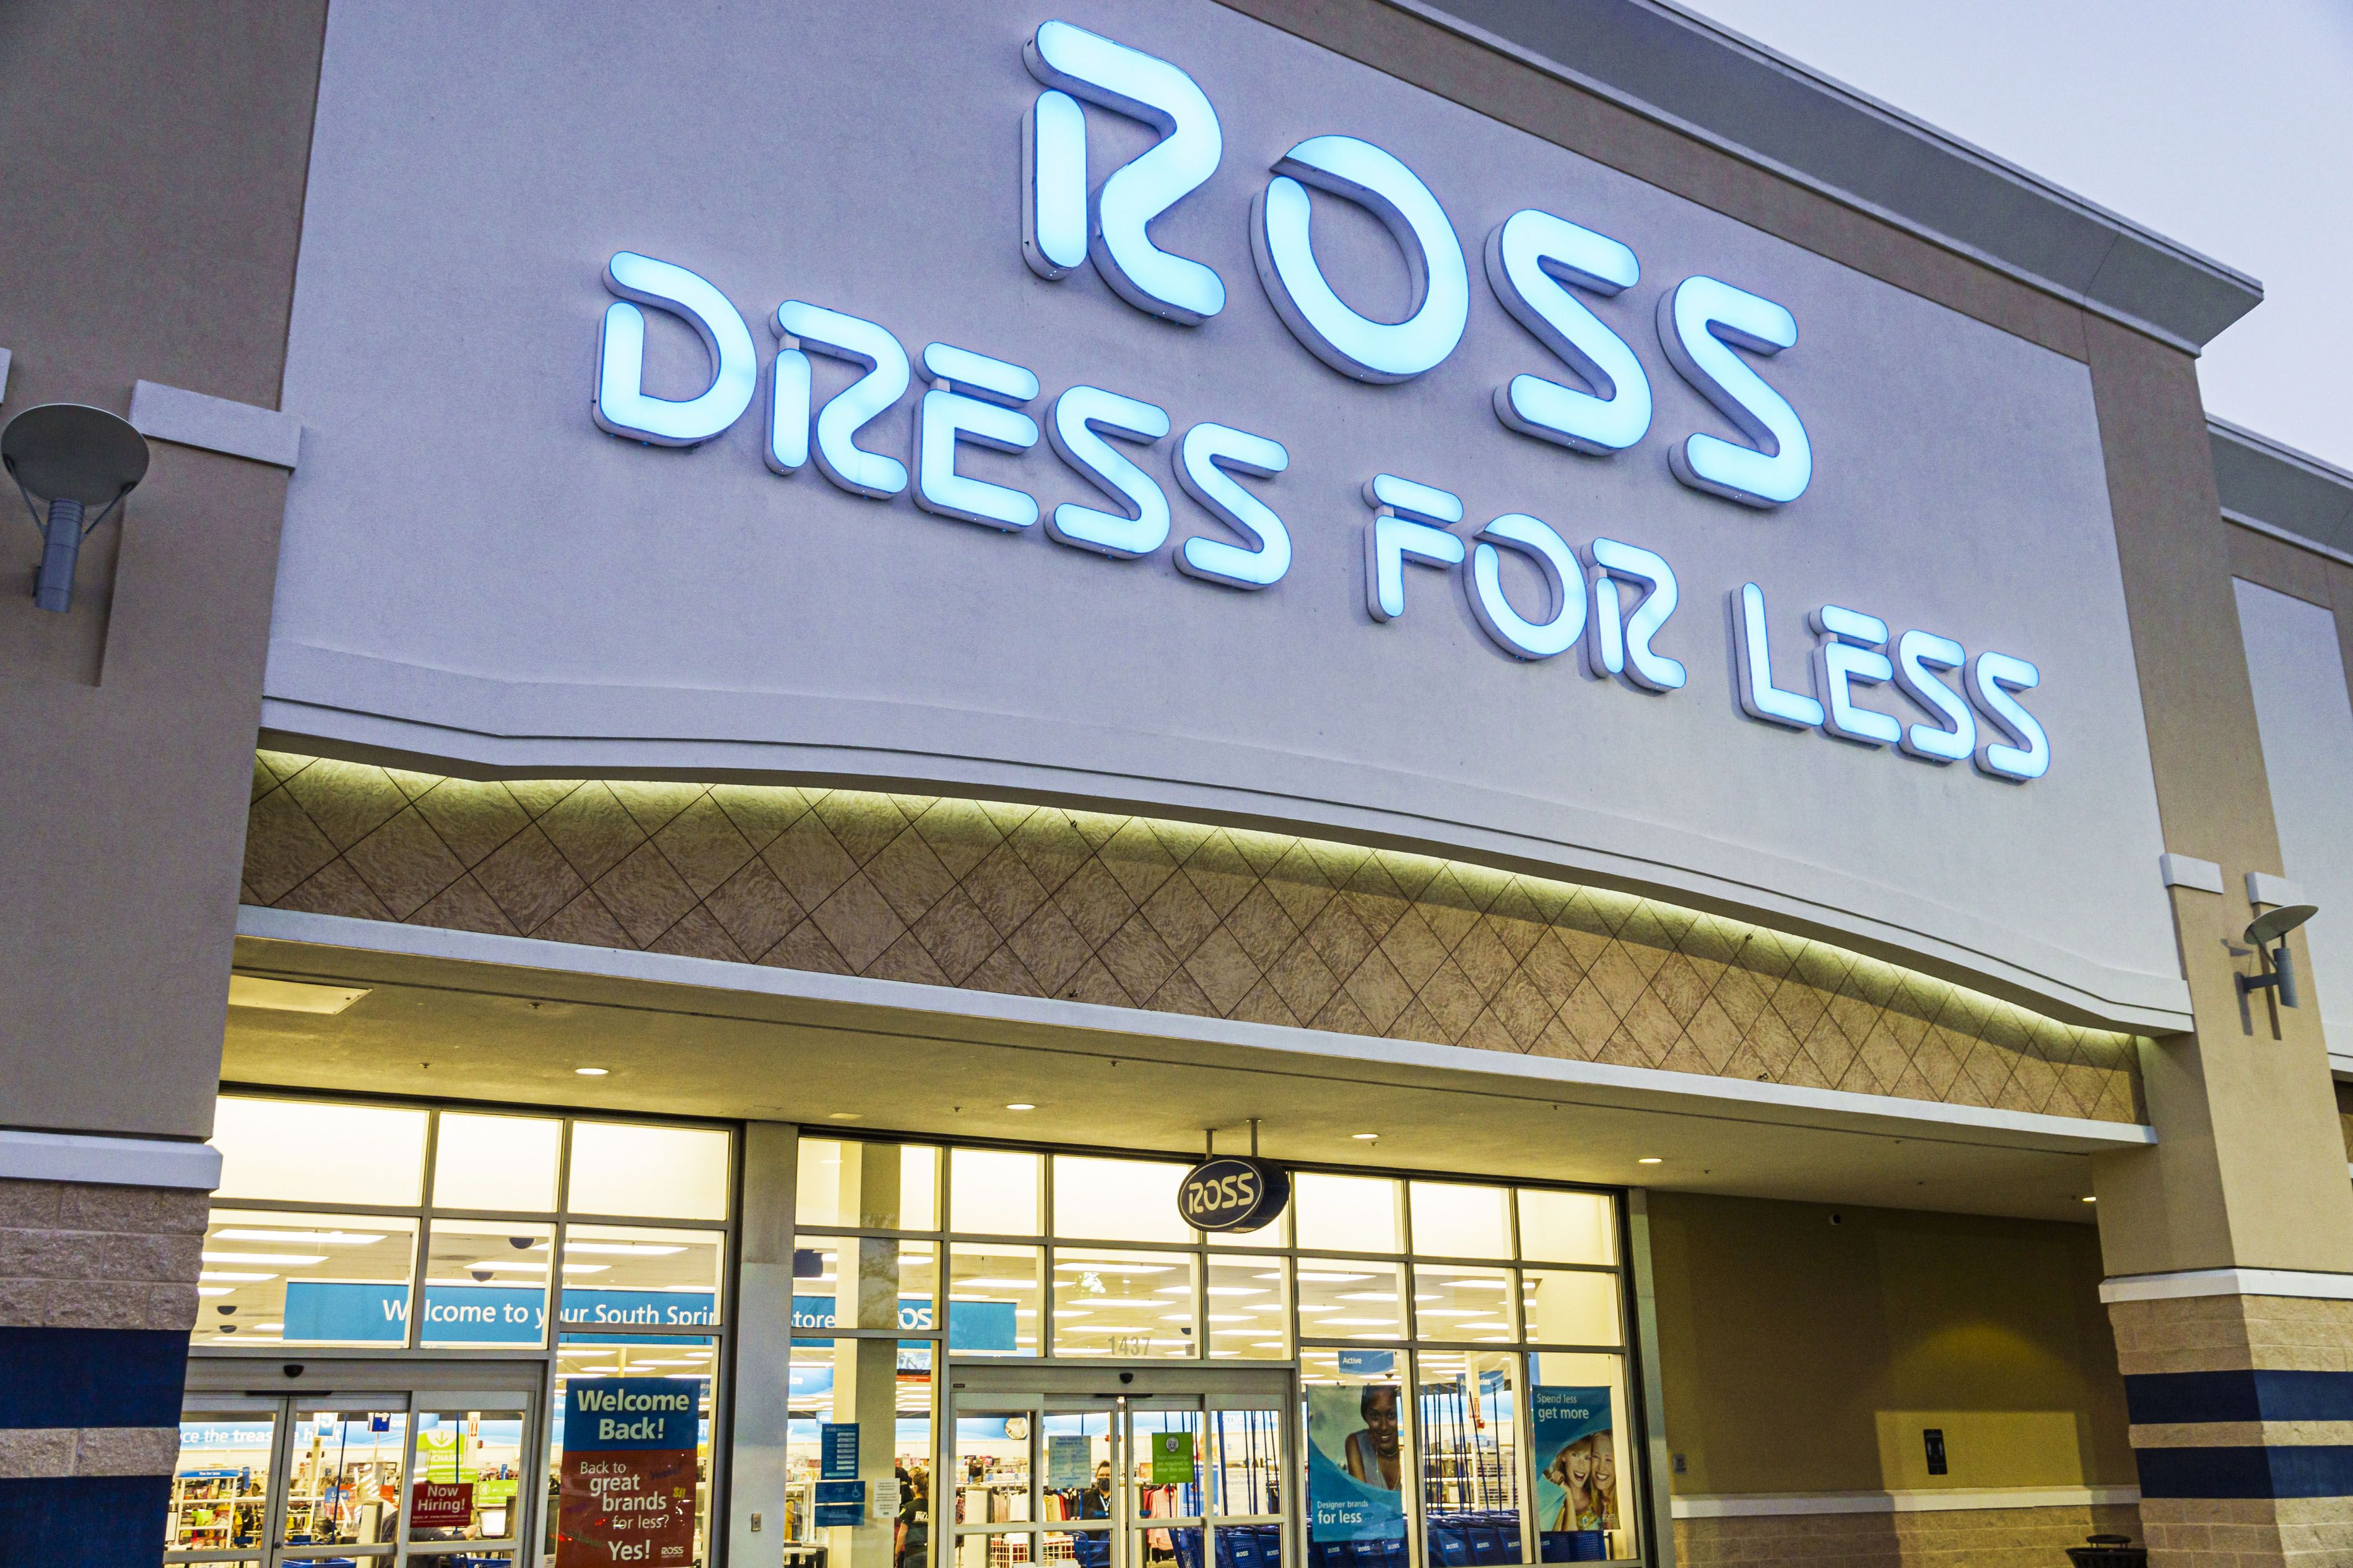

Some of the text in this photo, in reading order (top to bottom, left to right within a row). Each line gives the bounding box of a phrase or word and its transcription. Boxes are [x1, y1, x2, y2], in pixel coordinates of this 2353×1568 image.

[1029, 21, 1813, 503] ROSS
[596, 251, 2050, 779] DRESS FOR LESS
[1188, 1172, 1254, 1215] ROSS
[382, 1299, 496, 1322] Wlcome
[503, 1303, 528, 1323] to
[534, 1307, 589, 1329] yur
[595, 1304, 659, 1324] South
[791, 1310, 835, 1328] tore
[1108, 1336, 1150, 1356] 1437
[577, 1388, 690, 1412] Welcome
[1537, 1393, 1577, 1405] Spend less
[1538, 1407, 1589, 1422] get more
[204, 1429, 228, 1442] the
[599, 1417, 664, 1440] Back!
[580, 1461, 626, 1475] Back to
[427, 1485, 458, 1497] Now
[589, 1474, 640, 1497] great
[417, 1498, 466, 1513] Hiring!
[602, 1491, 667, 1512] brands
[1317, 1499, 1368, 1510] Designer brands
[612, 1514, 669, 1529] for less?
[1318, 1509, 1362, 1524] for less
[607, 1540, 650, 1561] Yes!
[661, 1546, 684, 1554] ROSS
